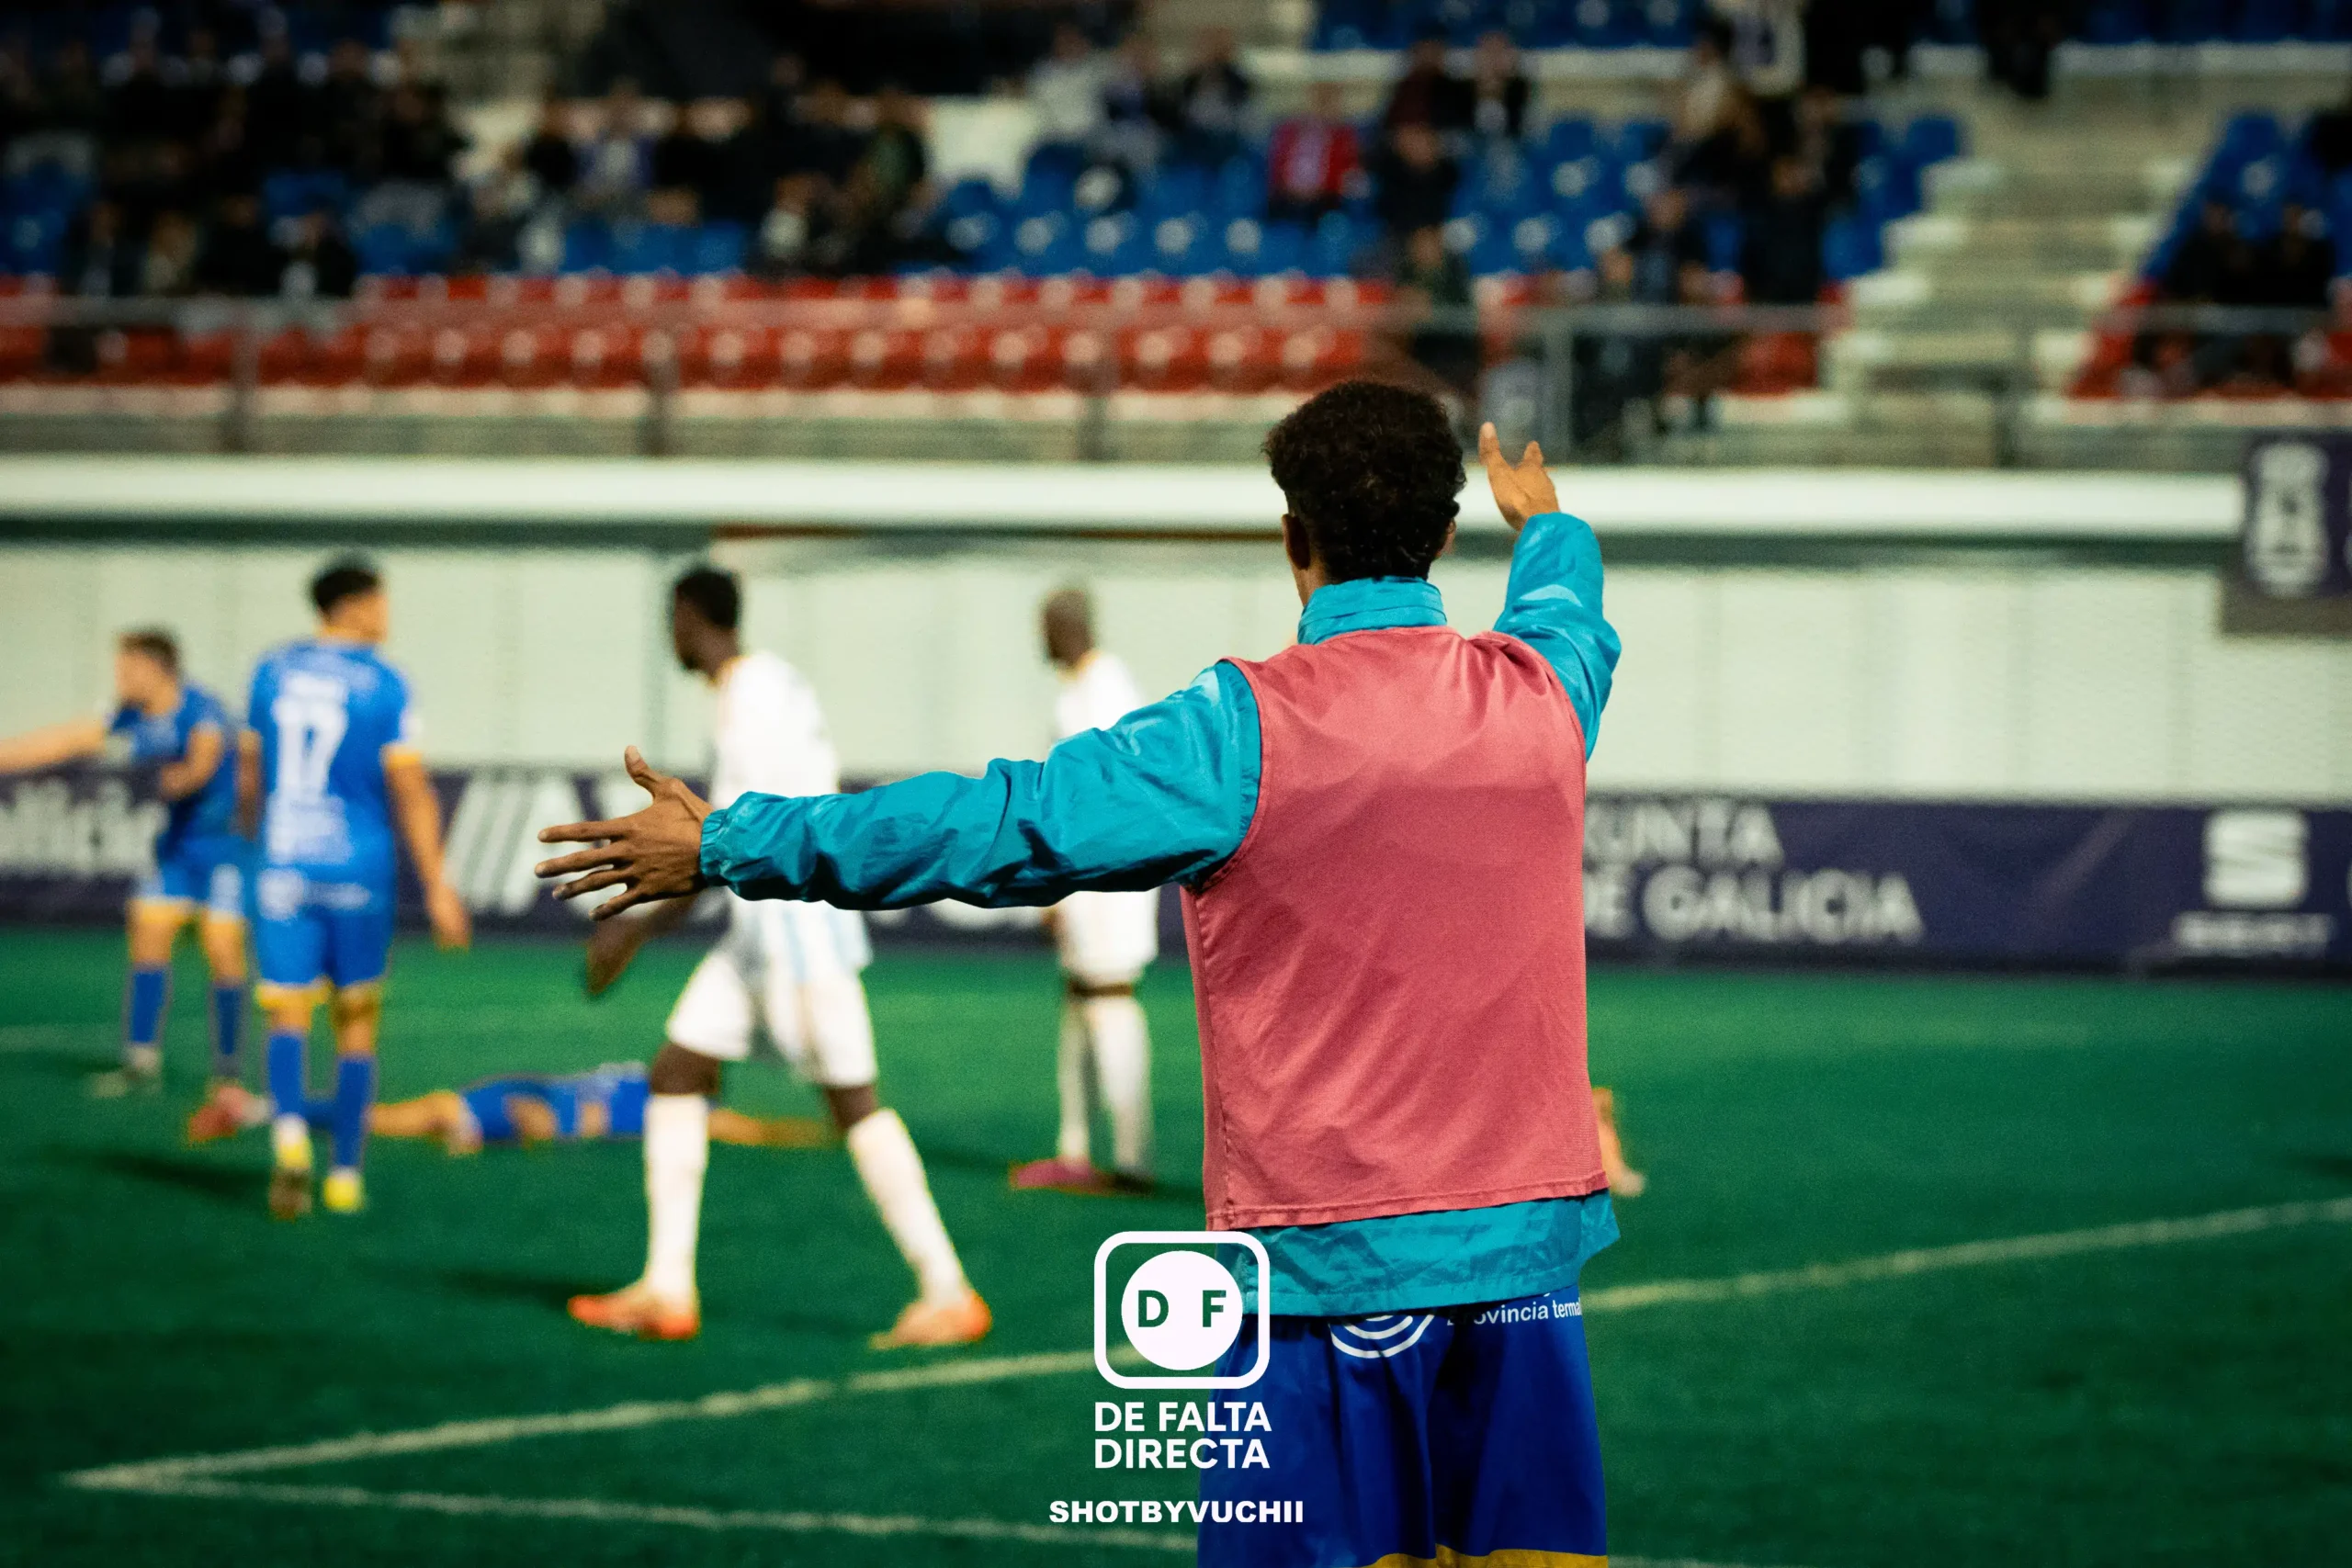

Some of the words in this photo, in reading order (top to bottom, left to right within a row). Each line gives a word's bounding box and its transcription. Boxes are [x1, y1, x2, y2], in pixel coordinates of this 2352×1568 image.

[1583, 802, 1784, 865] UNTA
[1583, 865, 1633, 939] E
[1642, 865, 1926, 945] GALICIA
